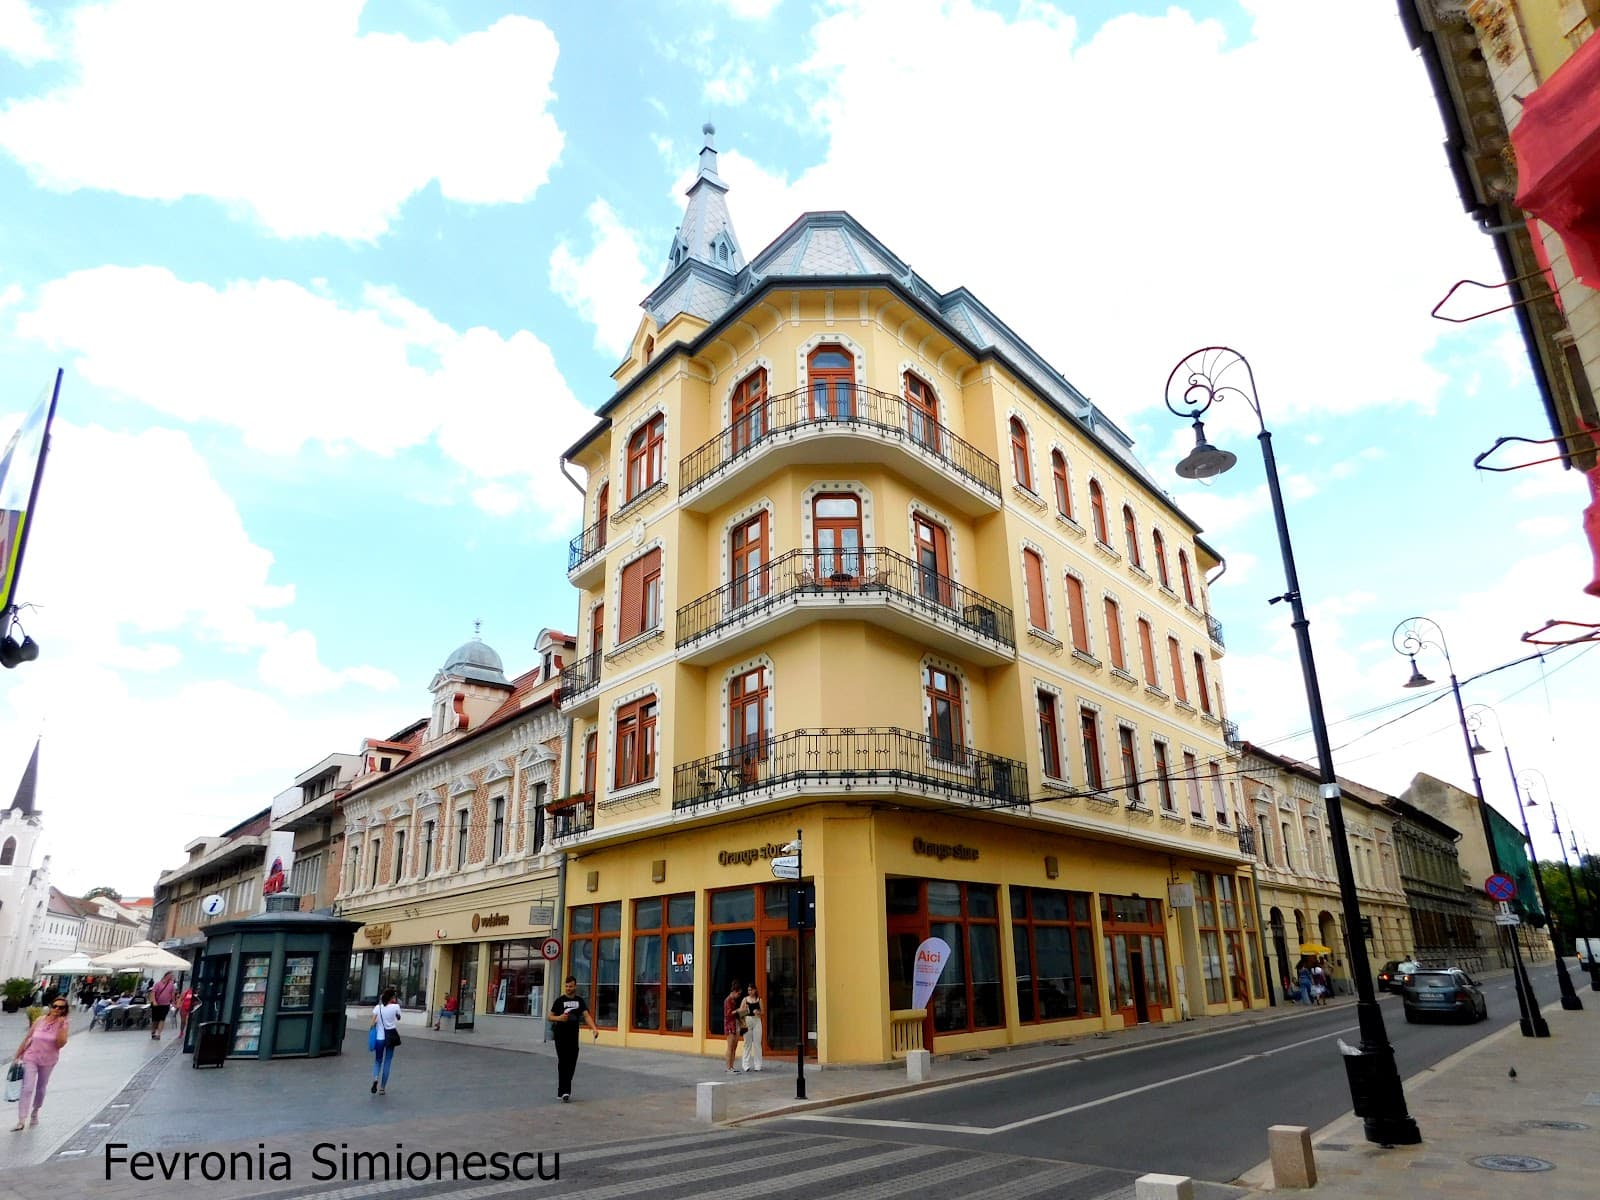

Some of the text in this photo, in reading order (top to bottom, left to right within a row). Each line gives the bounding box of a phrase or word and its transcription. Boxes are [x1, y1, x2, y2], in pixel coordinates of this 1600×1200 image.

[718, 848, 759, 865] Orange
[671, 950, 693, 966] Love
[917, 950, 941, 963] Aici
